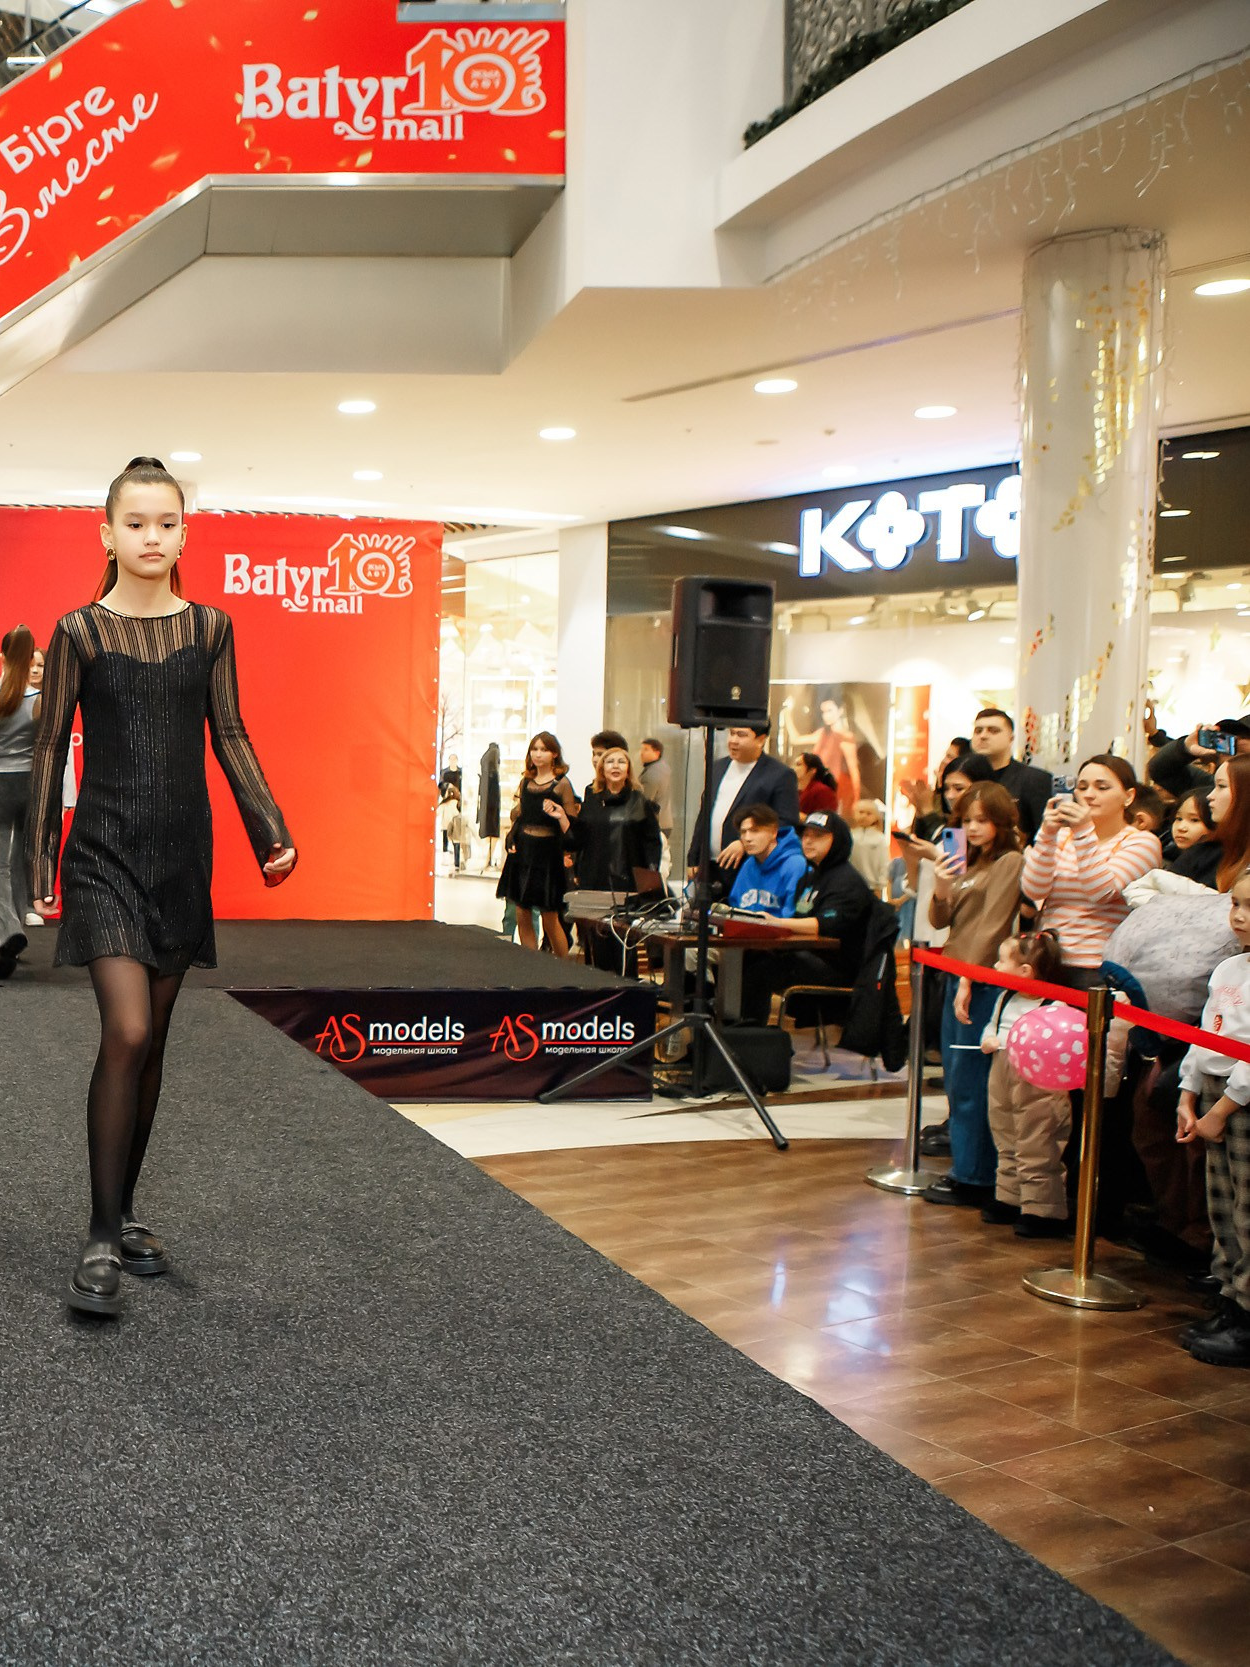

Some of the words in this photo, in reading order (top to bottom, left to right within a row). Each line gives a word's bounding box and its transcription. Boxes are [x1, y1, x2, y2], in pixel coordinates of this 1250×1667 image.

[241, 62, 408, 141] Batyr
[382, 114, 464, 141] mall
[223, 553, 330, 613] Batyr
[312, 595, 363, 615] mall
[314, 1013, 367, 1063] AS
[369, 1016, 465, 1042] models
[373, 1047, 425, 1057] модельная
[427, 1047, 458, 1055] школа
[489, 1013, 539, 1062] AS
[542, 1015, 635, 1040] models
[545, 1046, 596, 1056] модельная
